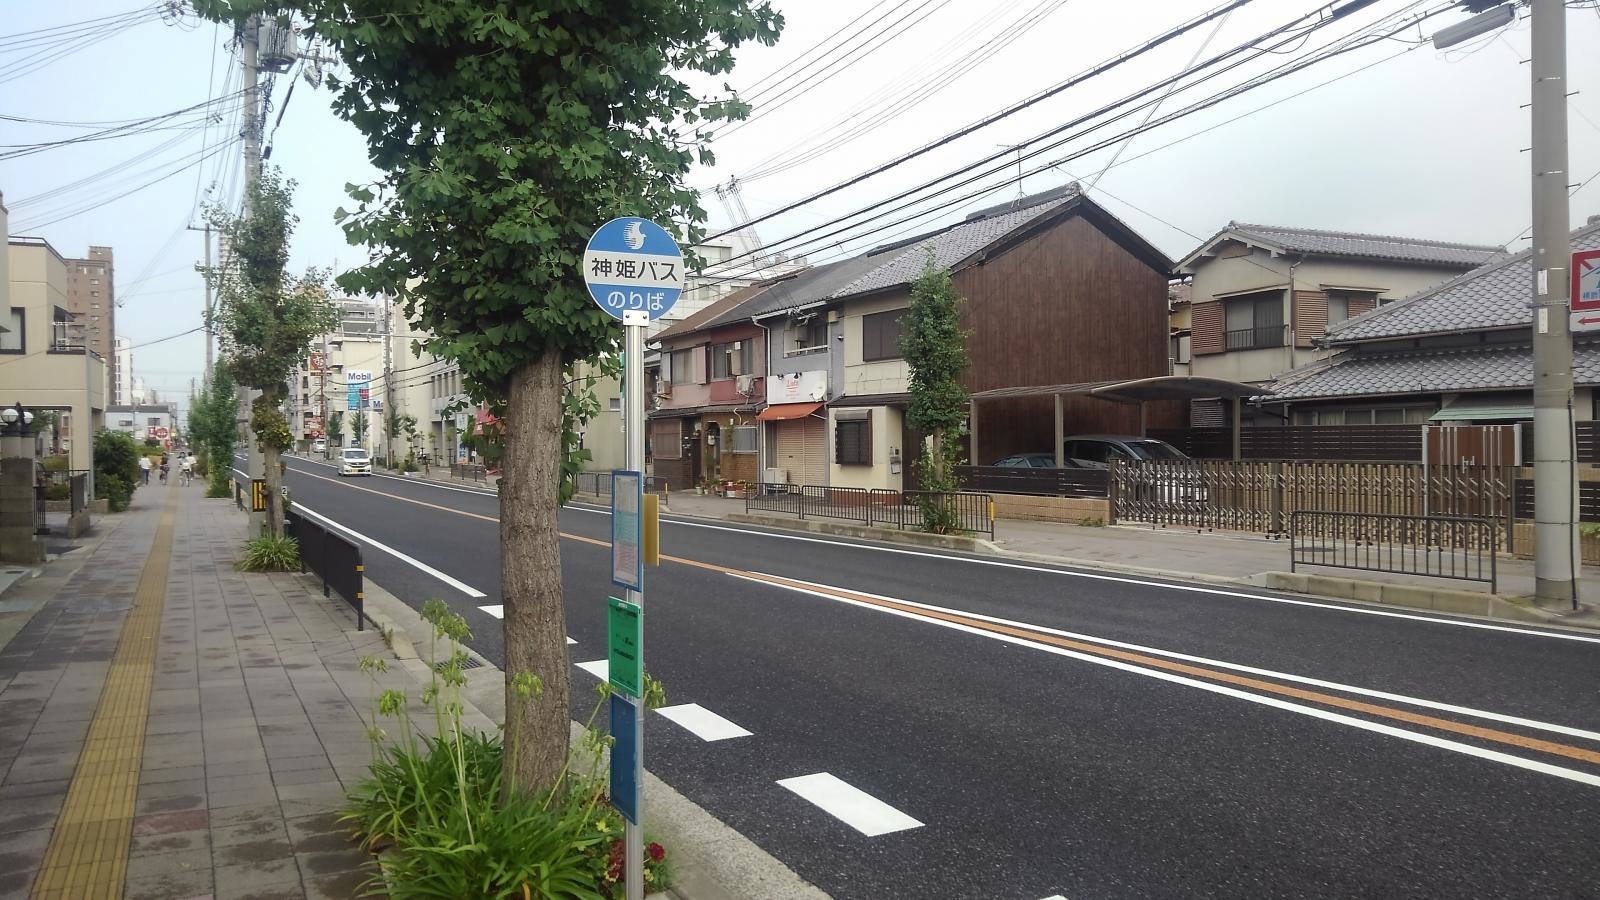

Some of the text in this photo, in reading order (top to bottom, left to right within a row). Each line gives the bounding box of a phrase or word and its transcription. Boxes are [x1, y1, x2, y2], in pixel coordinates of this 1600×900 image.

[591, 257, 678, 282] 神姫バス
[607, 291, 665, 311] のりば
[348, 372, 372, 381] Mobil
[281, 487, 287, 495] 2
